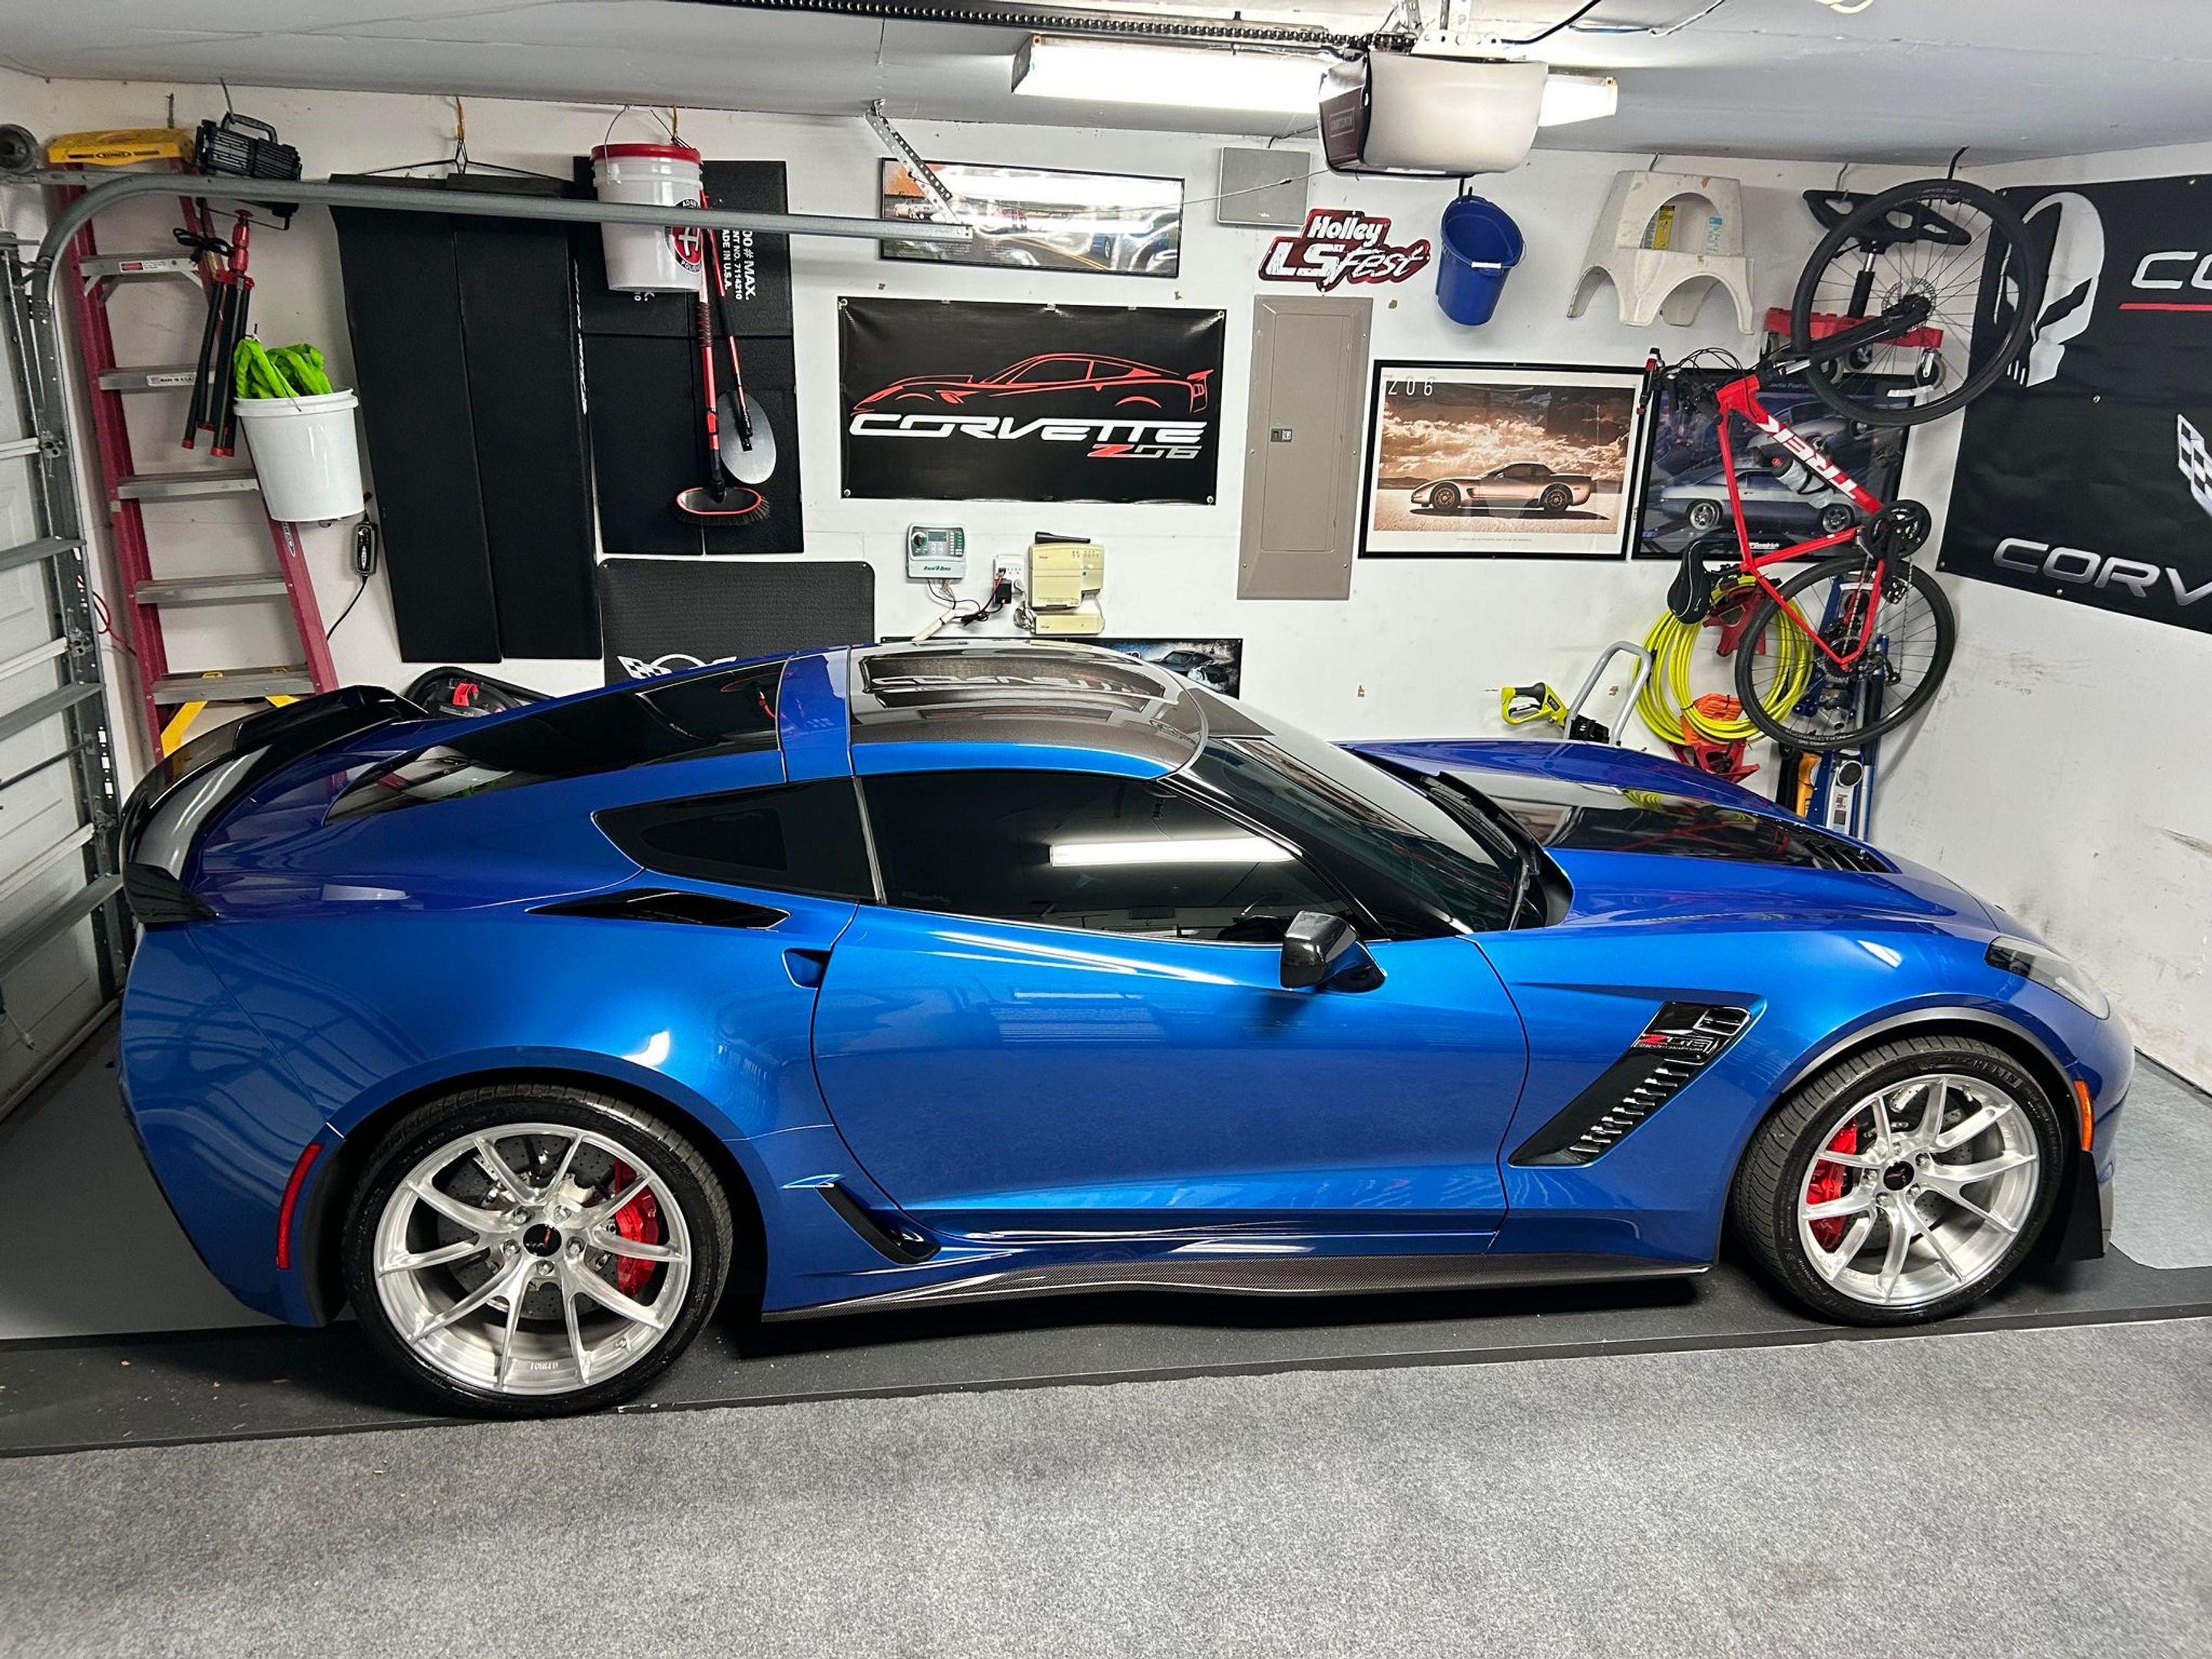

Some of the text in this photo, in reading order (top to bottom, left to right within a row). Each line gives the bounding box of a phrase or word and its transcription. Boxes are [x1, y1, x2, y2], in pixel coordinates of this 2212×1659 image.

[1307, 215, 1385, 247] Holley
[722, 229, 732, 290] ADE IN U.S.A.
[733, 245, 741, 261] NO.
[733, 263, 743, 300] 7114210
[743, 260, 757, 300] MAX.
[1382, 375, 1436, 396] Z06
[849, 413, 1207, 443] CORVETTE
[1087, 444, 1203, 459] Z06
[1757, 415, 1857, 499] TREK
[1993, 538, 2212, 606] CORV
